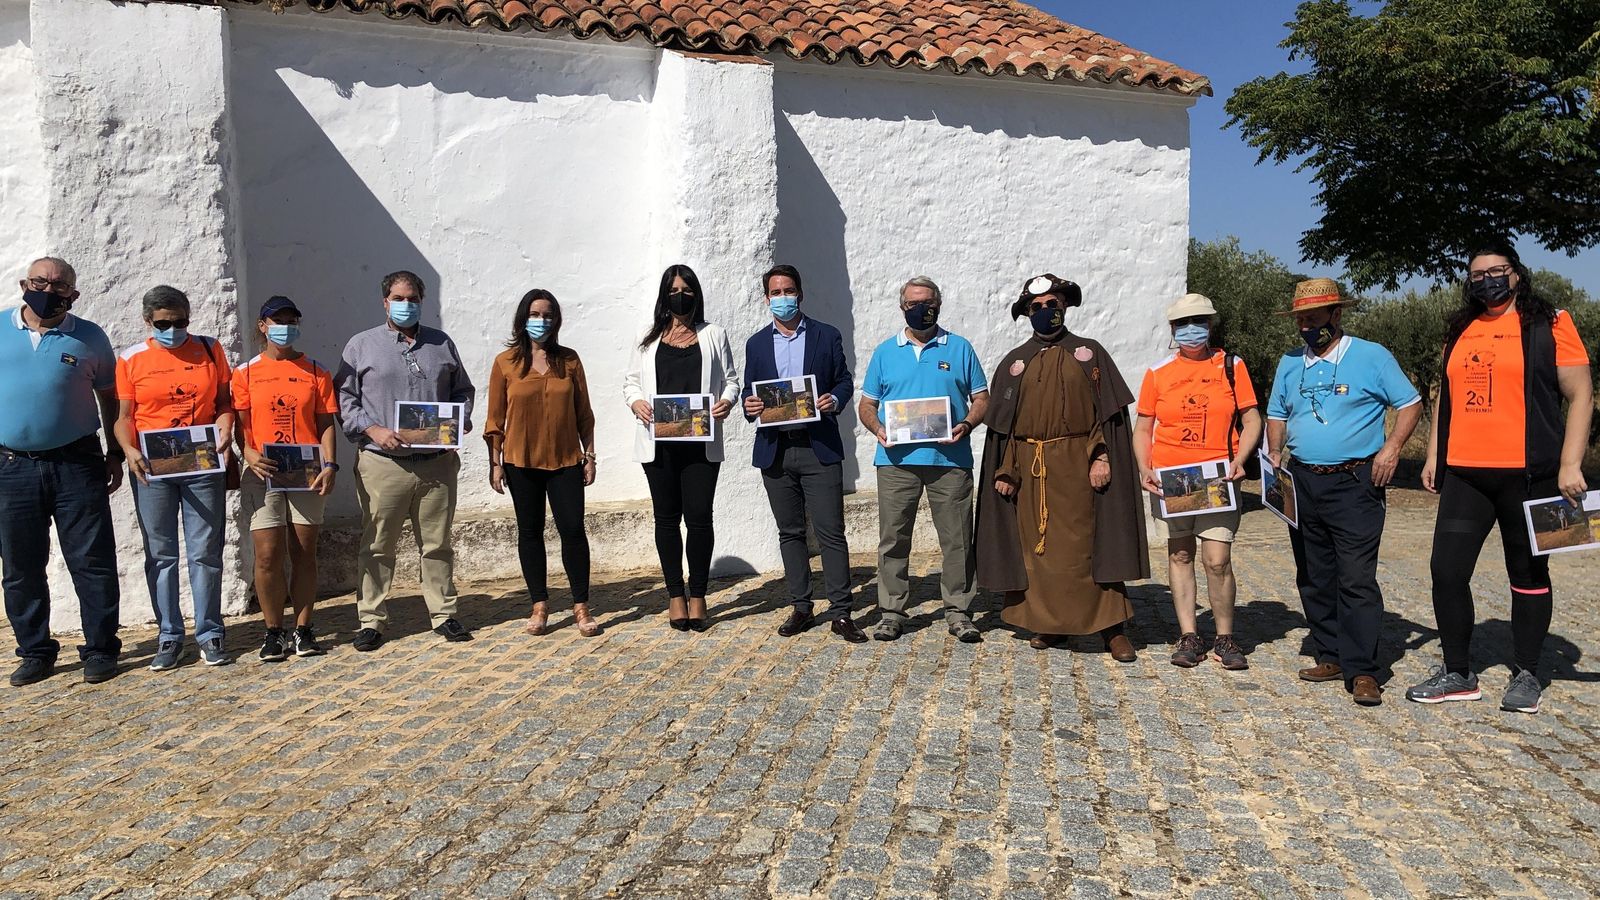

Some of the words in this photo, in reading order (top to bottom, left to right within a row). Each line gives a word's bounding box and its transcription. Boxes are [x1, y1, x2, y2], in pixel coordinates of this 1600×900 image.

[1466, 391, 1485, 406] 20
[274, 430, 291, 444] 20
[1181, 428, 1199, 442] 20
